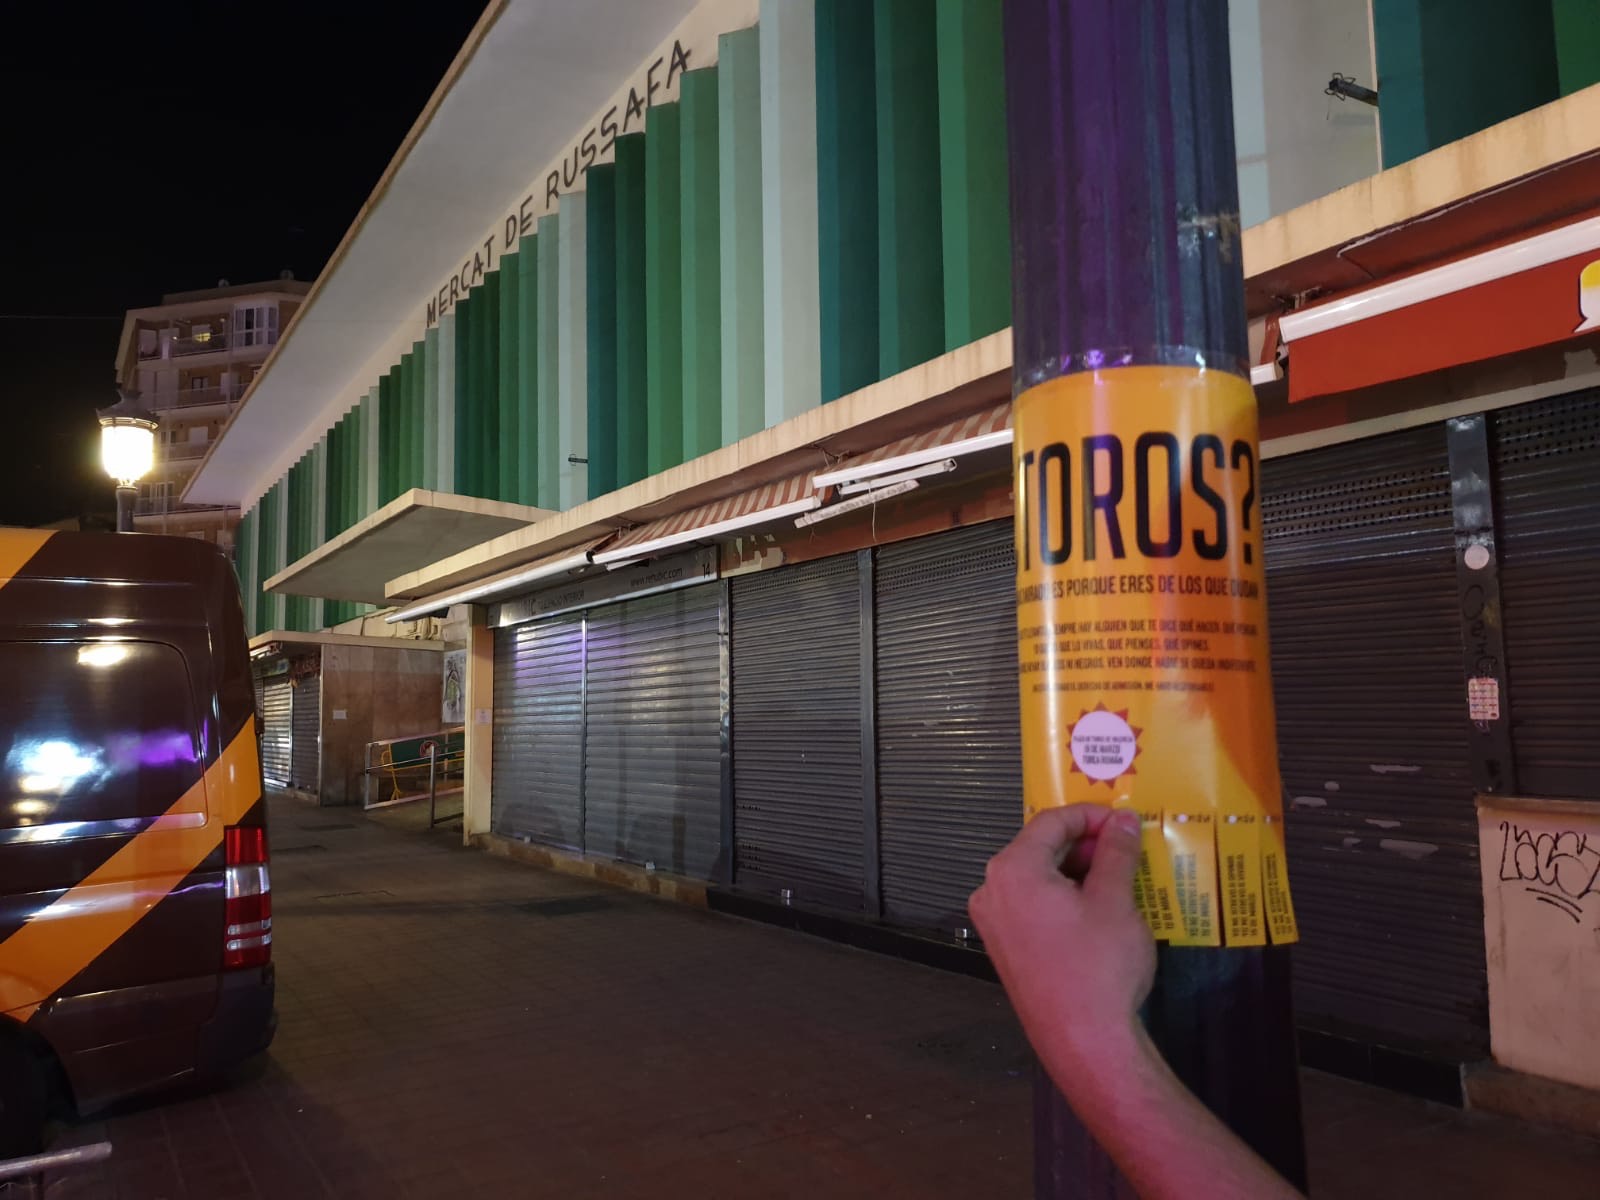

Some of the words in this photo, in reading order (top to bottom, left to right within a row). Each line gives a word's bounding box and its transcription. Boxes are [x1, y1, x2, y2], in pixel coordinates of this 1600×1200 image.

[426, 235, 495, 328] MERCAT
[505, 195, 533, 250] DE
[545, 39, 692, 210] RUSSAFA
[1066, 576, 1116, 597] PORQUE
[1120, 575, 1153, 593] ERES
[1159, 576, 1172, 593] DE
[1178, 576, 1201, 594] LOS
[1205, 576, 1228, 596] QUE
